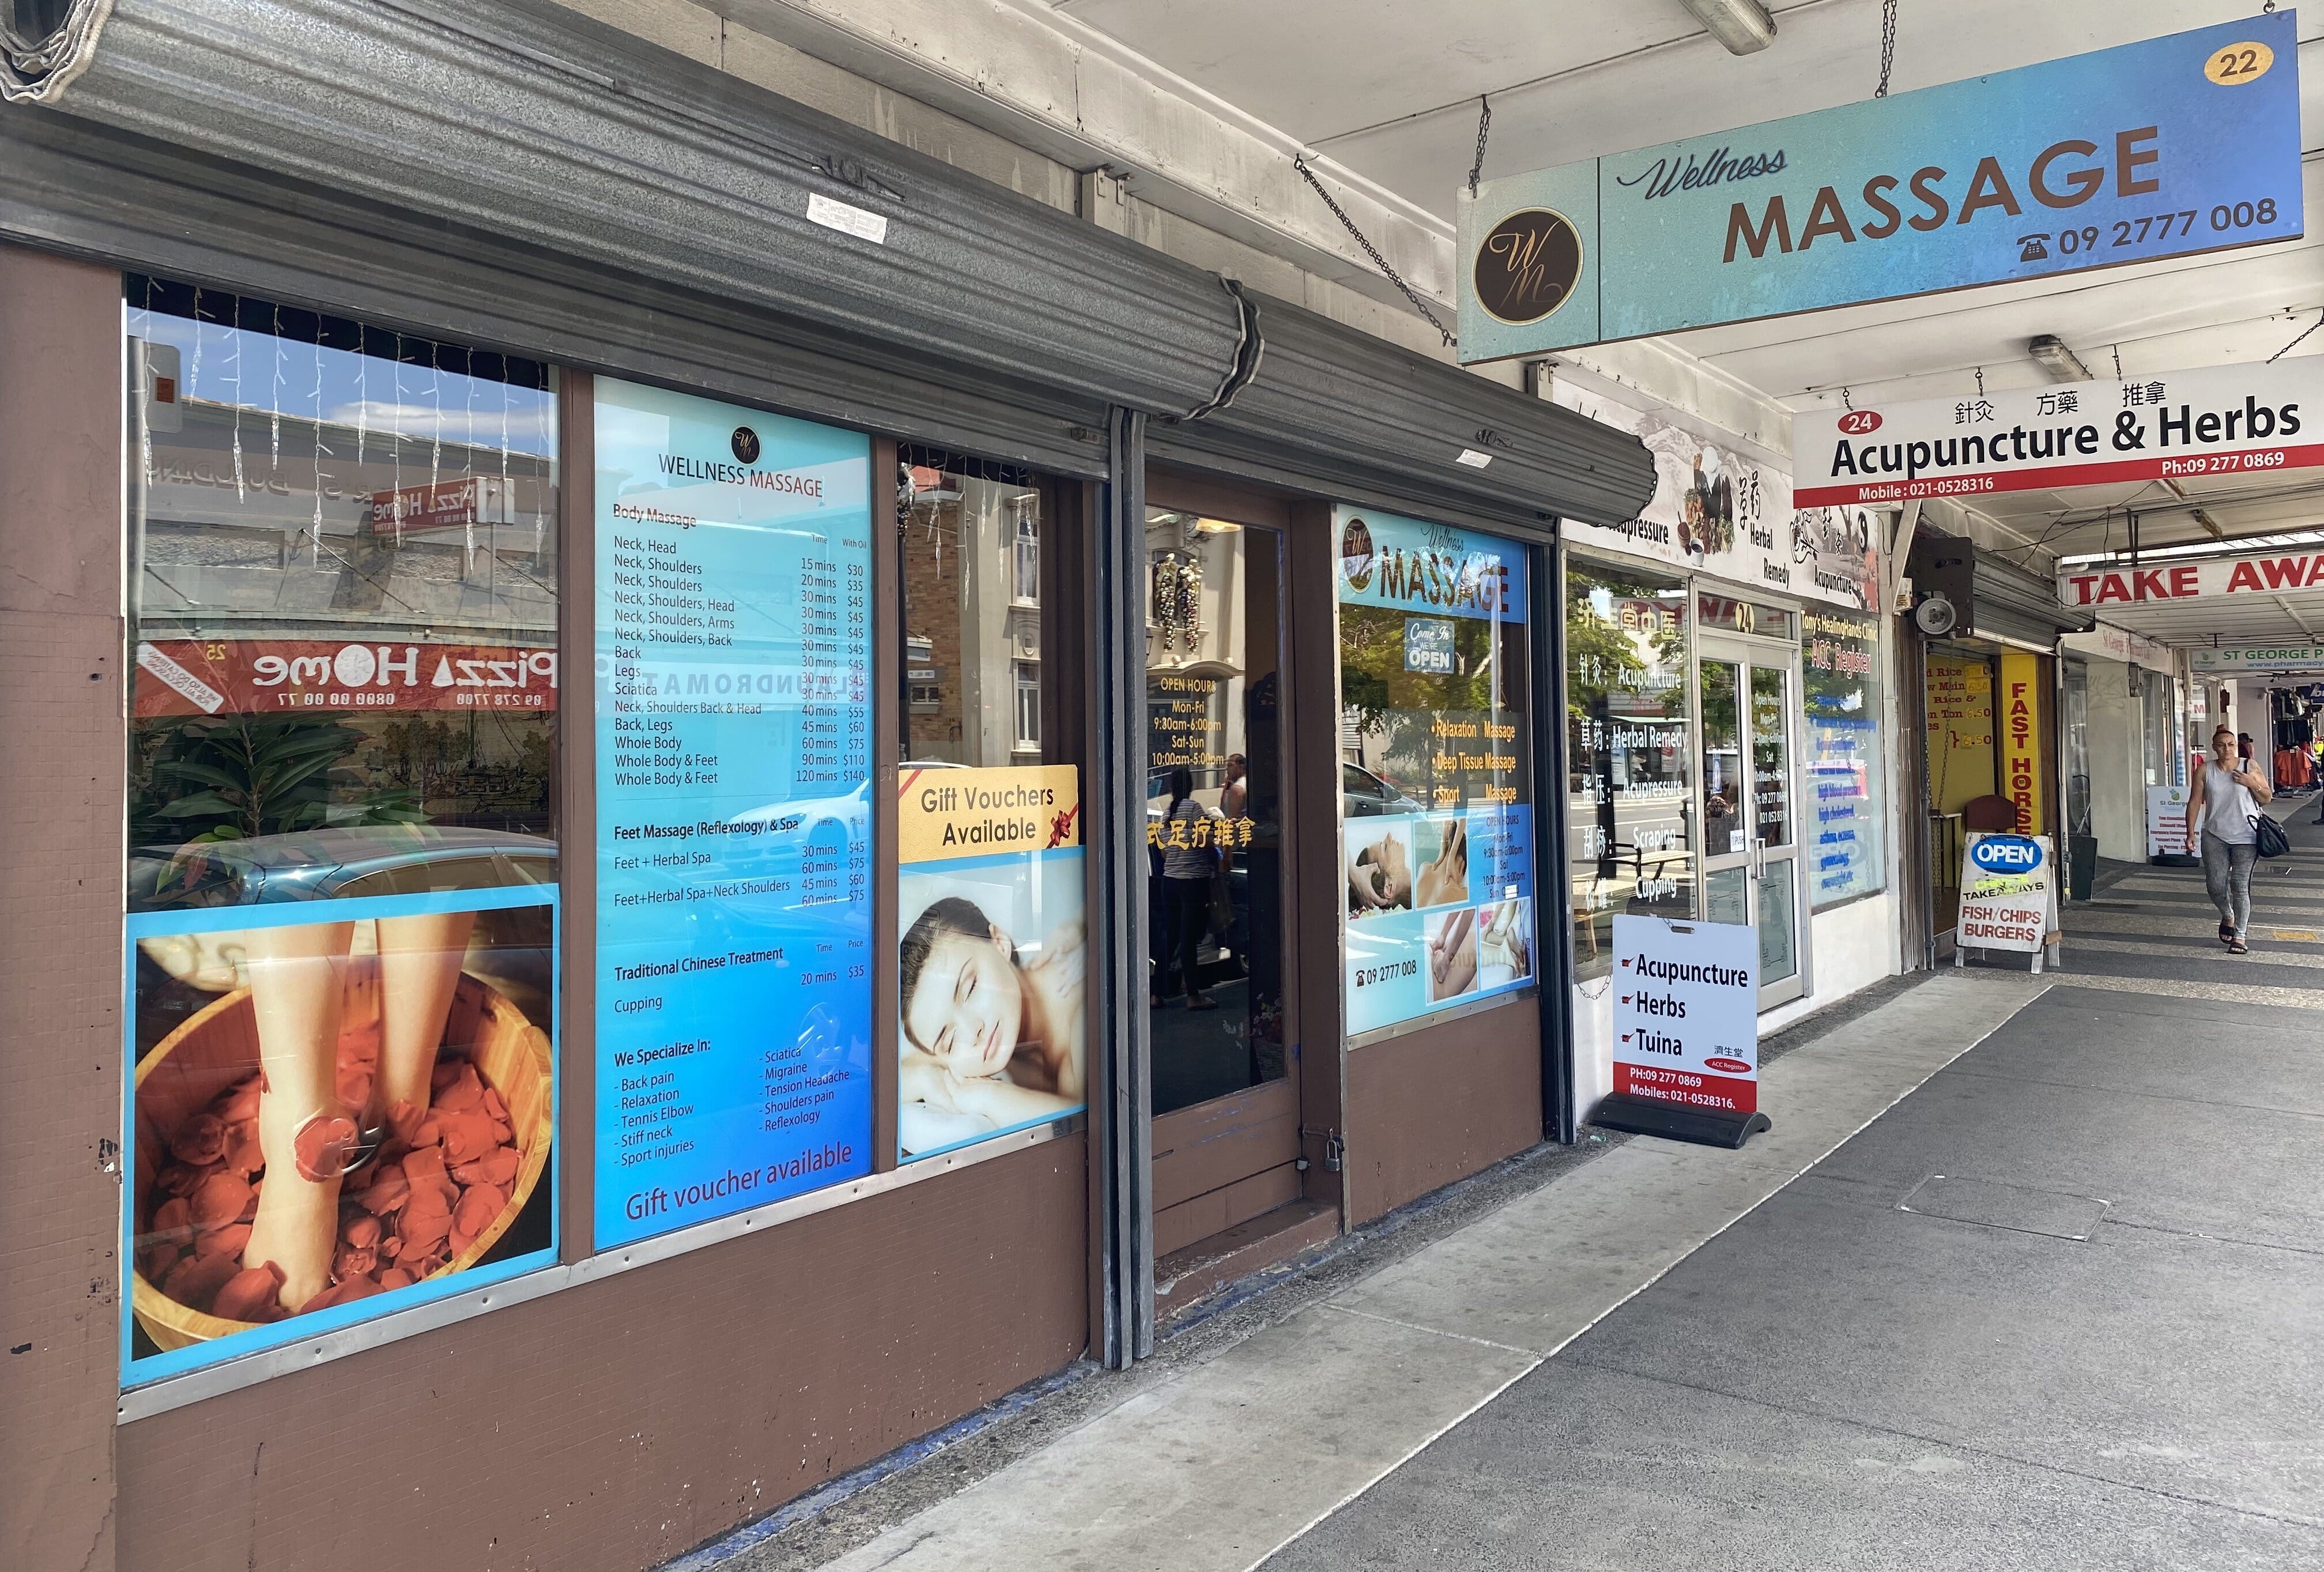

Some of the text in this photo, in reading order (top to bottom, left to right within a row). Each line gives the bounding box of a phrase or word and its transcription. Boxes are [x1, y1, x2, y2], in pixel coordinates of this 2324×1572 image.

[2220, 50, 2257, 78] 22
[1617, 147, 1787, 199] Wellness
[1723, 126, 2159, 263] MASSAGE
[2059, 198, 2277, 254] 09 2777 008
[1955, 381, 2166, 424] 針灸 方藥 推拿
[1848, 413, 1872, 432] 24
[1831, 395, 2301, 480] Acupuncture & Herbs
[2162, 451, 2285, 475] Ph:09 277 0869
[659, 454, 823, 497] WELLNESS MASSAGE
[1910, 477, 1993, 496] 021-0528316
[614, 504, 696, 529] Body Massage
[812, 534, 866, 549] Time With Oil
[1421, 525, 1464, 551] Wellness
[1609, 519, 1669, 544] upressure
[1750, 523, 1773, 550] Herbal
[614, 536, 676, 554] Neck, Head
[1380, 546, 1509, 613] MASSAGE
[1764, 557, 1790, 590] Remedy
[1814, 565, 1852, 595] Acupuncture
[2069, 566, 2199, 605] TAKE
[1738, 606, 1751, 633] 24
[1801, 610, 1820, 635] Tony's
[1862, 623, 1877, 642] Clinic
[1410, 623, 1450, 642] Come In
[1409, 651, 1450, 668] OPEN
[1812, 638, 1870, 680] ACC Register
[2223, 651, 2241, 660] ST
[2245, 649, 2309, 659] GEORGE
[615, 664, 640, 680] Legs
[1618, 663, 1681, 692] Acupuncture
[1937, 668, 1962, 677] Rice
[615, 682, 657, 696] Sciatica
[1160, 677, 1217, 692] OPEN HOURS
[615, 701, 761, 714] Neck, Shoulders Back & Head
[1172, 700, 1204, 713] Mon-Fri
[1755, 694, 1780, 708] Open Hours
[1154, 717, 1221, 733] 9:30am-6:00pm
[2010, 683, 2029, 748] FAST
[1172, 735, 1204, 748] Sat-Sun
[1436, 719, 1515, 742] Relaxation Massage
[1613, 725, 1688, 753] Herbal Remedy
[1152, 752, 1224, 767] 10:00am-5:00pm
[1437, 752, 1516, 774] Deep Tissue Massage
[797, 770, 864, 782] 120 mins $140
[922, 785, 1053, 813] Gift Vouchers
[1439, 784, 1516, 805] Sport Massage
[1623, 778, 1682, 804] Acupressure
[1761, 792, 1767, 804] 09
[1768, 792, 1776, 803] 277
[614, 818, 798, 840] Feet Massage (Reflexology) & Spa
[1487, 815, 1519, 827] OPEN HOURS
[1759, 812, 1768, 823] 021
[942, 817, 1036, 846] Available
[1633, 823, 1676, 851] Scraping
[1977, 844, 2033, 864] OPEN
[1636, 876, 1676, 902] Cupping
[1962, 906, 2041, 924] FISH/CHIPS
[1964, 923, 2035, 941] BURGERS
[614, 947, 783, 981] Traditional Chinese Treatment
[801, 965, 864, 985] 20 mins $35
[1367, 959, 1416, 985] 09 2777 008
[1636, 953, 1748, 987] Acupuncture
[614, 996, 662, 1015] Cupping
[1637, 991, 1686, 1019] Herbs
[614, 1039, 711, 1066] We Specialize In:
[1636, 1028, 1682, 1056] Tuina
[1630, 1068, 1701, 1088] PH:09 277 0869
[1723, 1062, 1745, 1072] Register
[1630, 1084, 1669, 1099] Mobiles:
[765, 1110, 820, 1132] Reflexology
[626, 1141, 852, 1220] Gift voucher available
